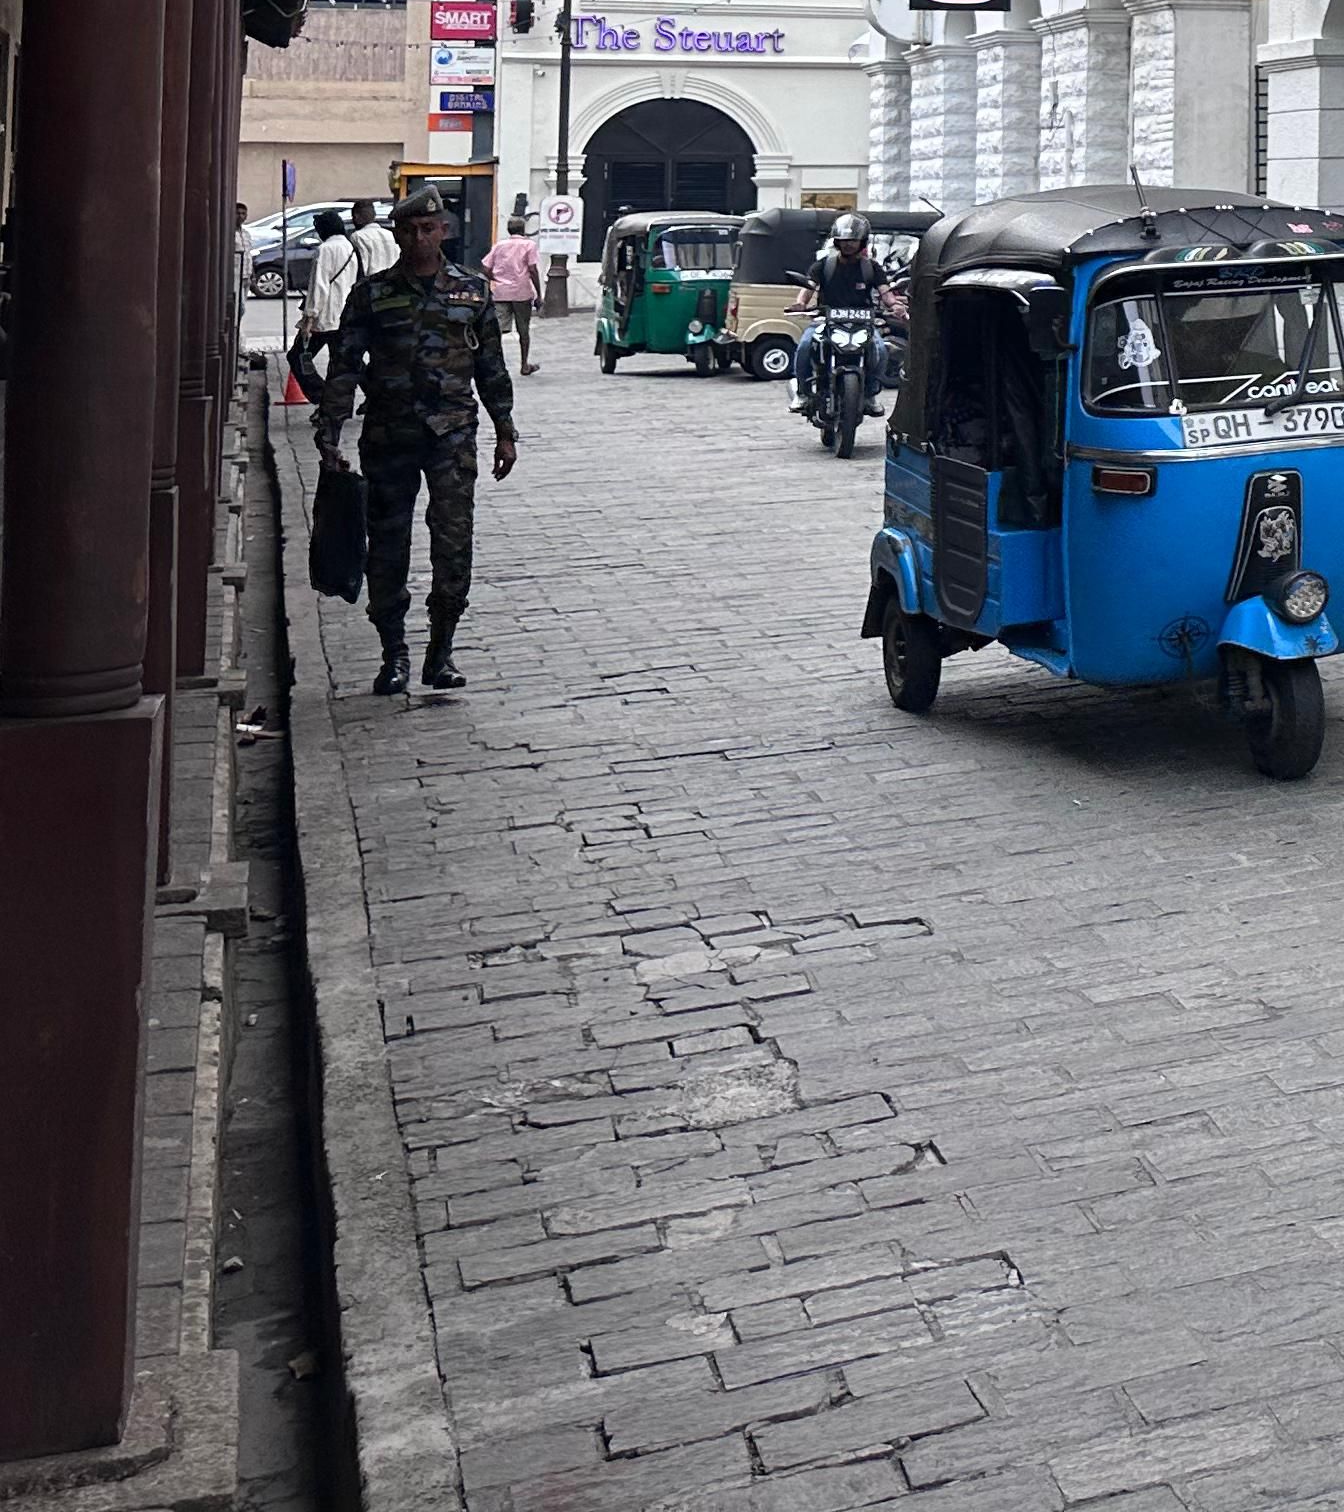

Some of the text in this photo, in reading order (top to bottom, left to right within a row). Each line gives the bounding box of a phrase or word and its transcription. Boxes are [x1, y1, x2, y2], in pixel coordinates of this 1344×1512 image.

[434, 11, 491, 25] SMART
[571, 15, 785, 53] The Steuart
[1187, 427, 1211, 445] SP
[1212, 413, 1252, 439] QH
